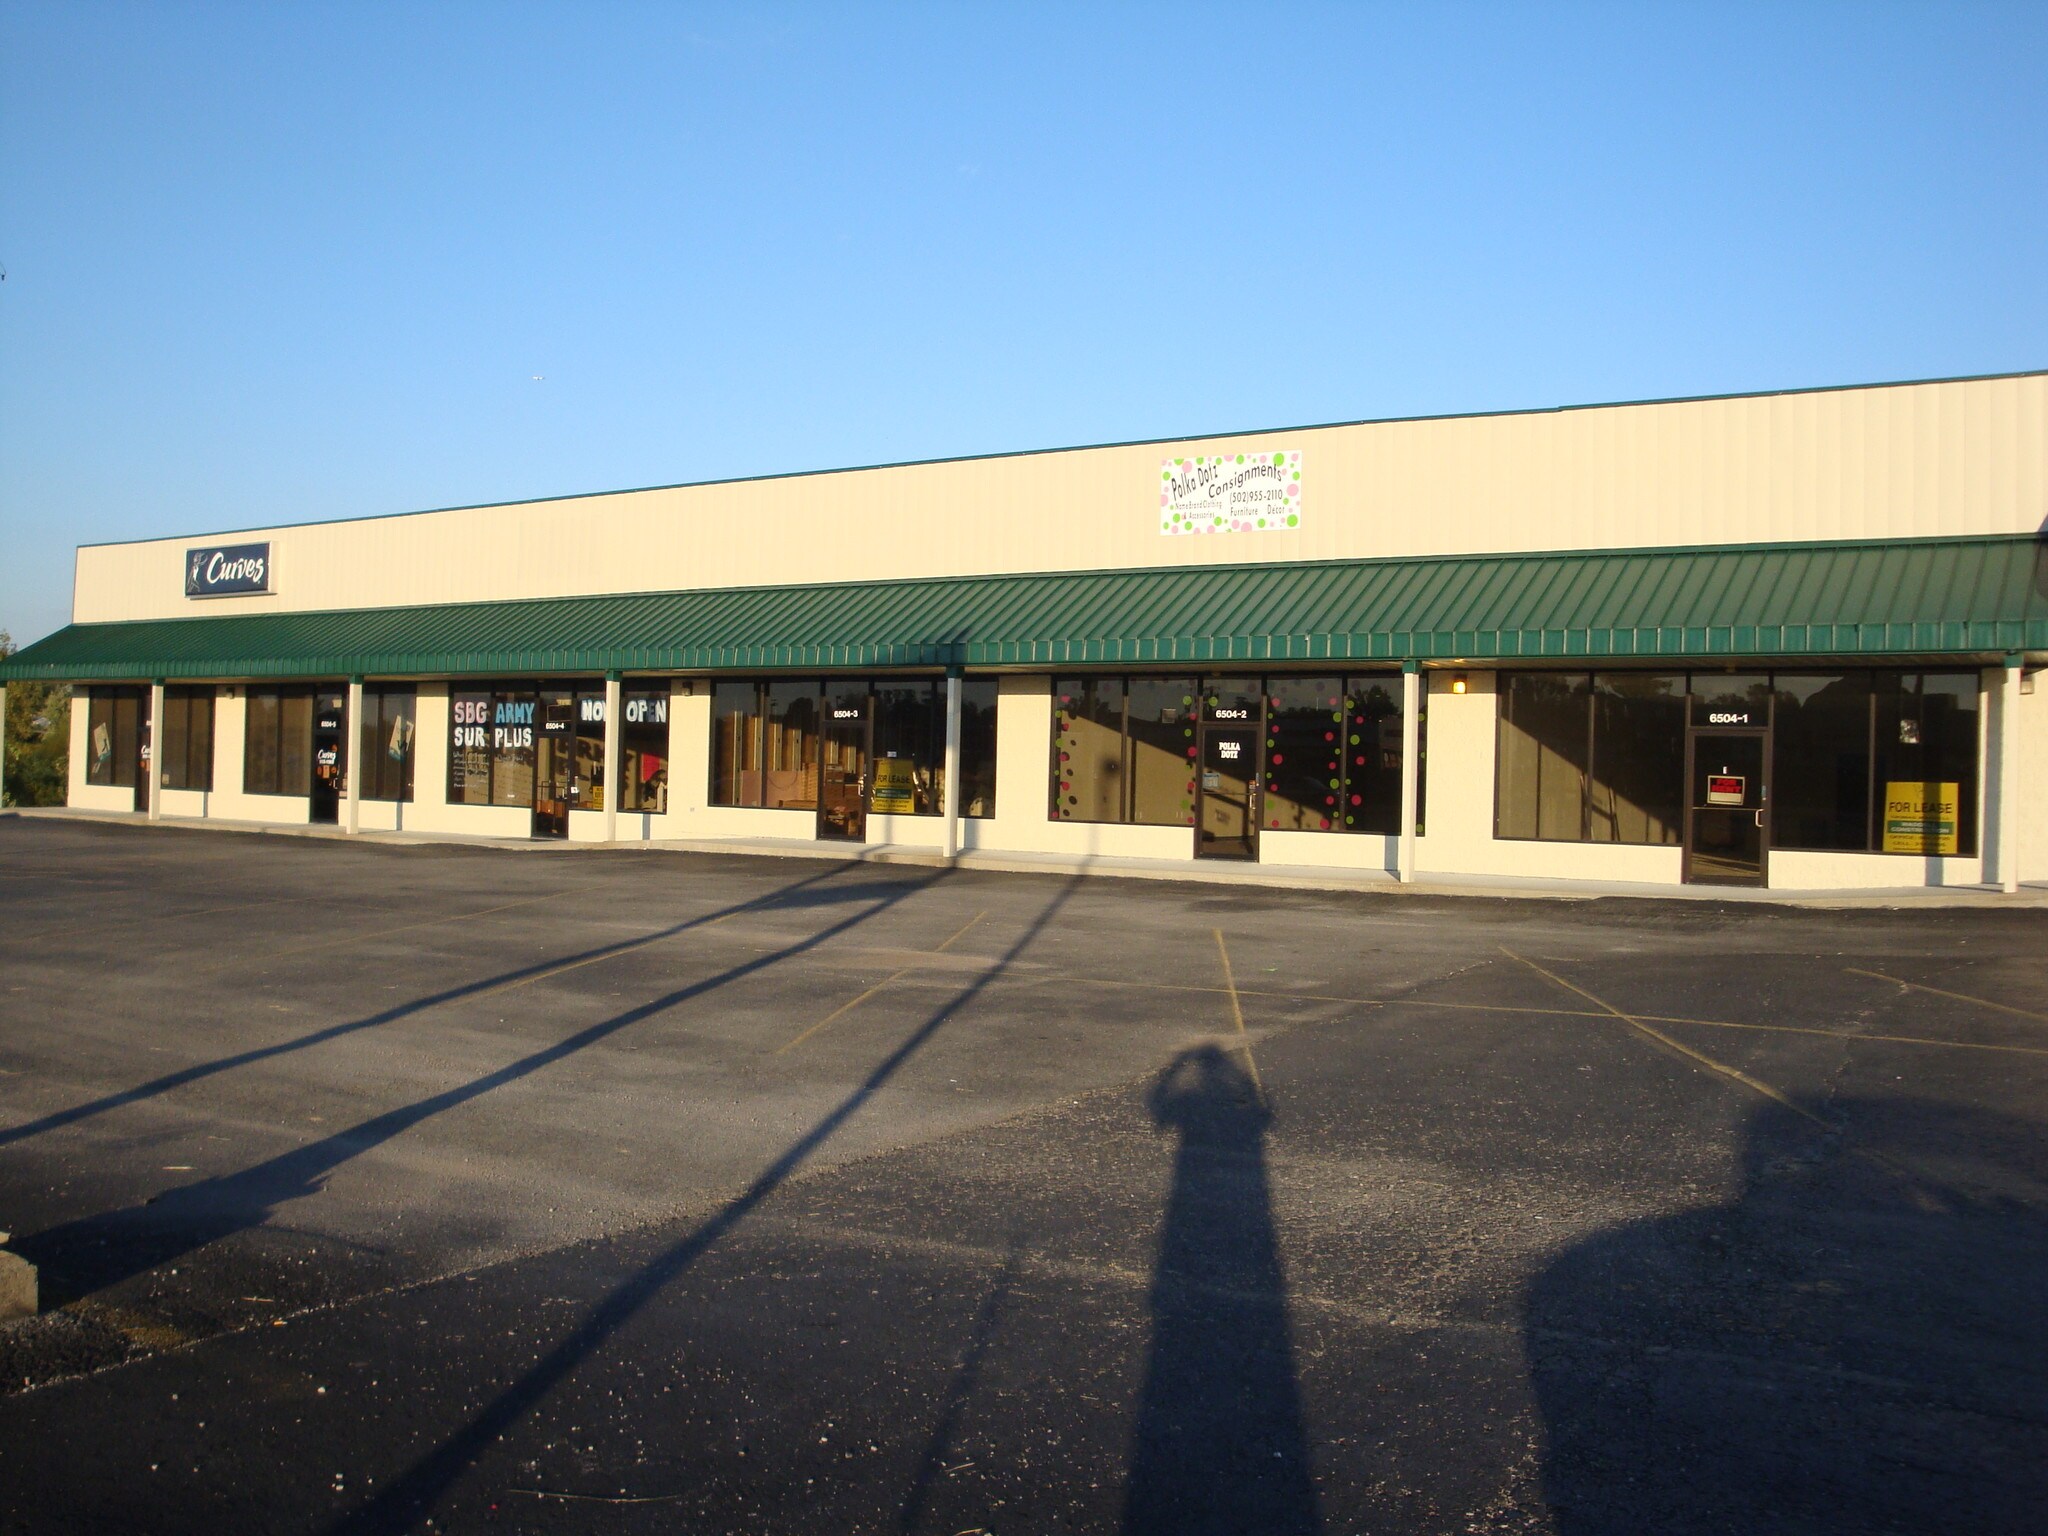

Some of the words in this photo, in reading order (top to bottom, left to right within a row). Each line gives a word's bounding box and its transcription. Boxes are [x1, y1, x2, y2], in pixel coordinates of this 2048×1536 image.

[1171, 472, 1196, 501] Polka
[1197, 463, 1218, 487] Dotz
[1208, 463, 1282, 498] Consignments
[1230, 506, 1258, 516] Furniture
[206, 551, 264, 584] Curves
[454, 701, 488, 724] SBG
[495, 702, 535, 724] ARMY
[626, 699, 667, 723] OPEN
[833, 710, 858, 718] 6504-3
[1215, 709, 1247, 719] 6504-2
[1709, 713, 1748, 723] 6504-1
[545, 722, 564, 730] 6504-4
[454, 727, 485, 747] SUR
[494, 727, 532, 748] PLUS
[1218, 742, 1241, 751] POLKA
[1220, 750, 1239, 759] DOTZ
[877, 774, 888, 783] FOR
[889, 774, 911, 784] LEASE
[1889, 801, 1911, 813] FOR
[1913, 802, 1953, 814] LEASE
